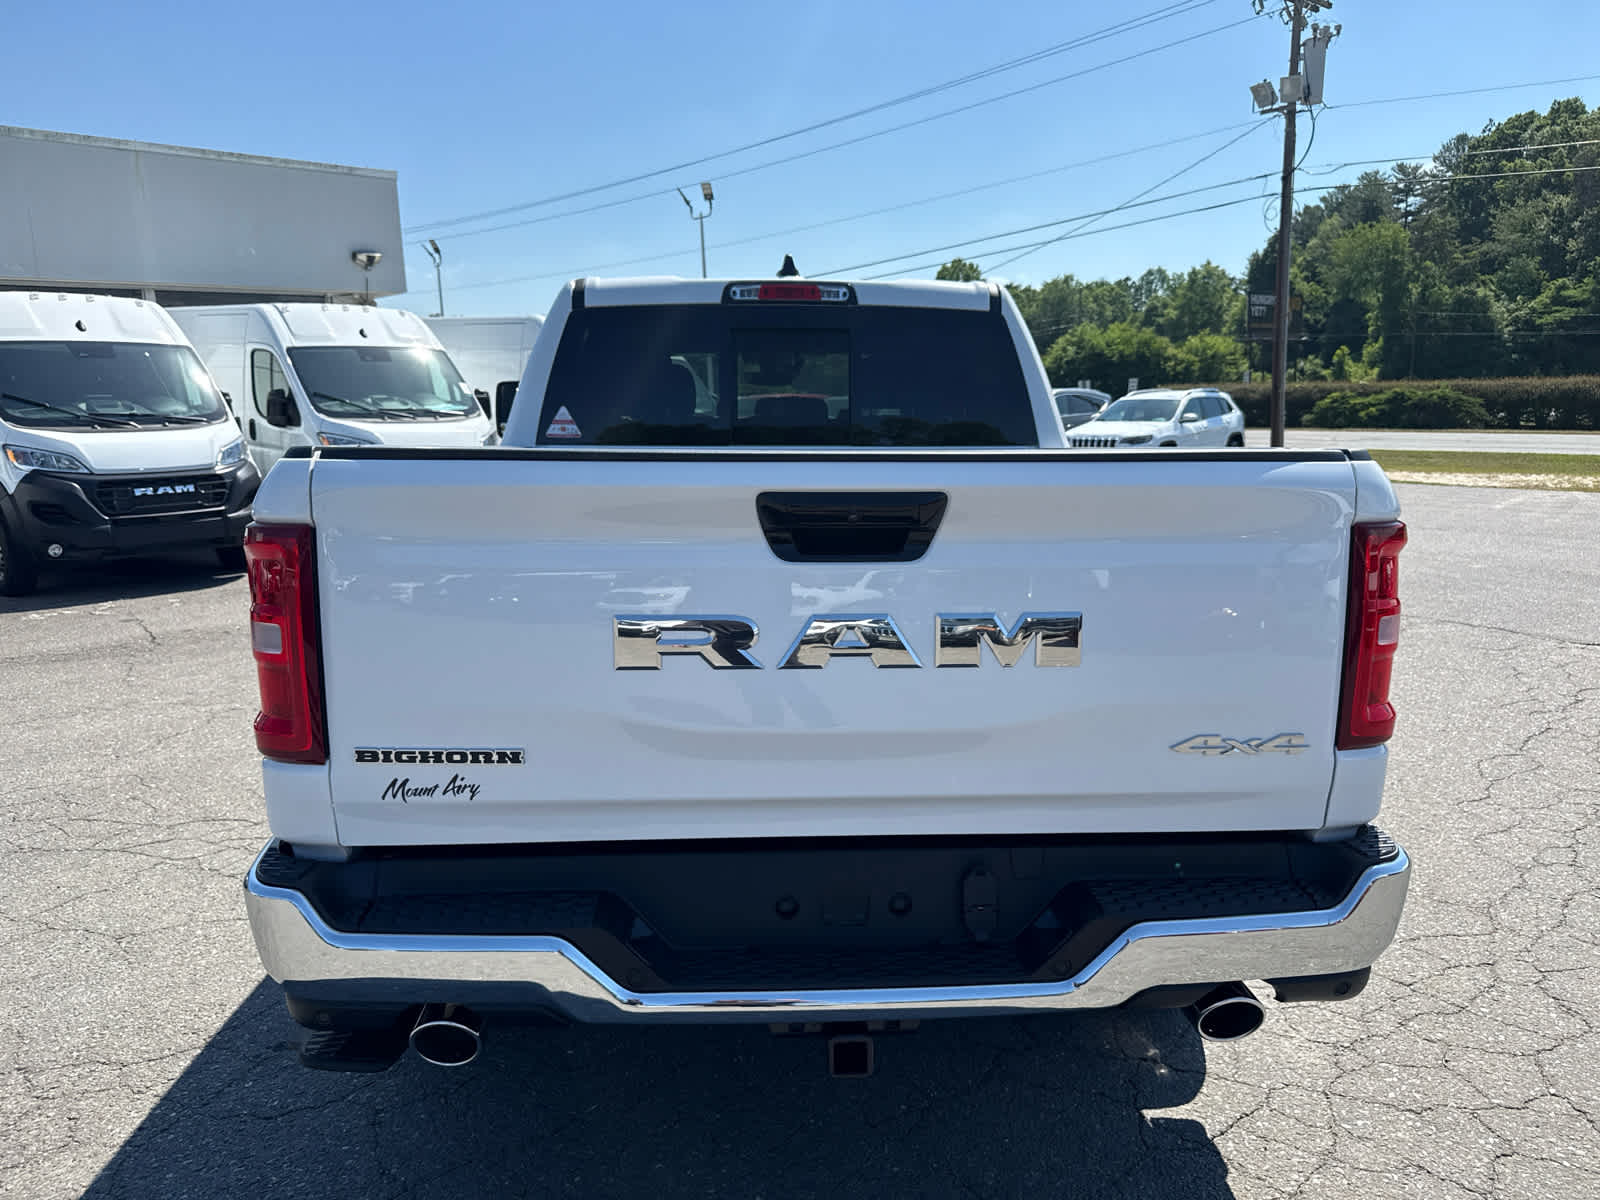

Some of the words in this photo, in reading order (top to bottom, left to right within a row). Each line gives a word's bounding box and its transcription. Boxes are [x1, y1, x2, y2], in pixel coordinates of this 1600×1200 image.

[133, 484, 195, 496] RAM
[613, 612, 1084, 671] RAM
[354, 747, 525, 765] BIGHORN
[381, 777, 439, 803] Mount
[442, 773, 480, 800] Airy
